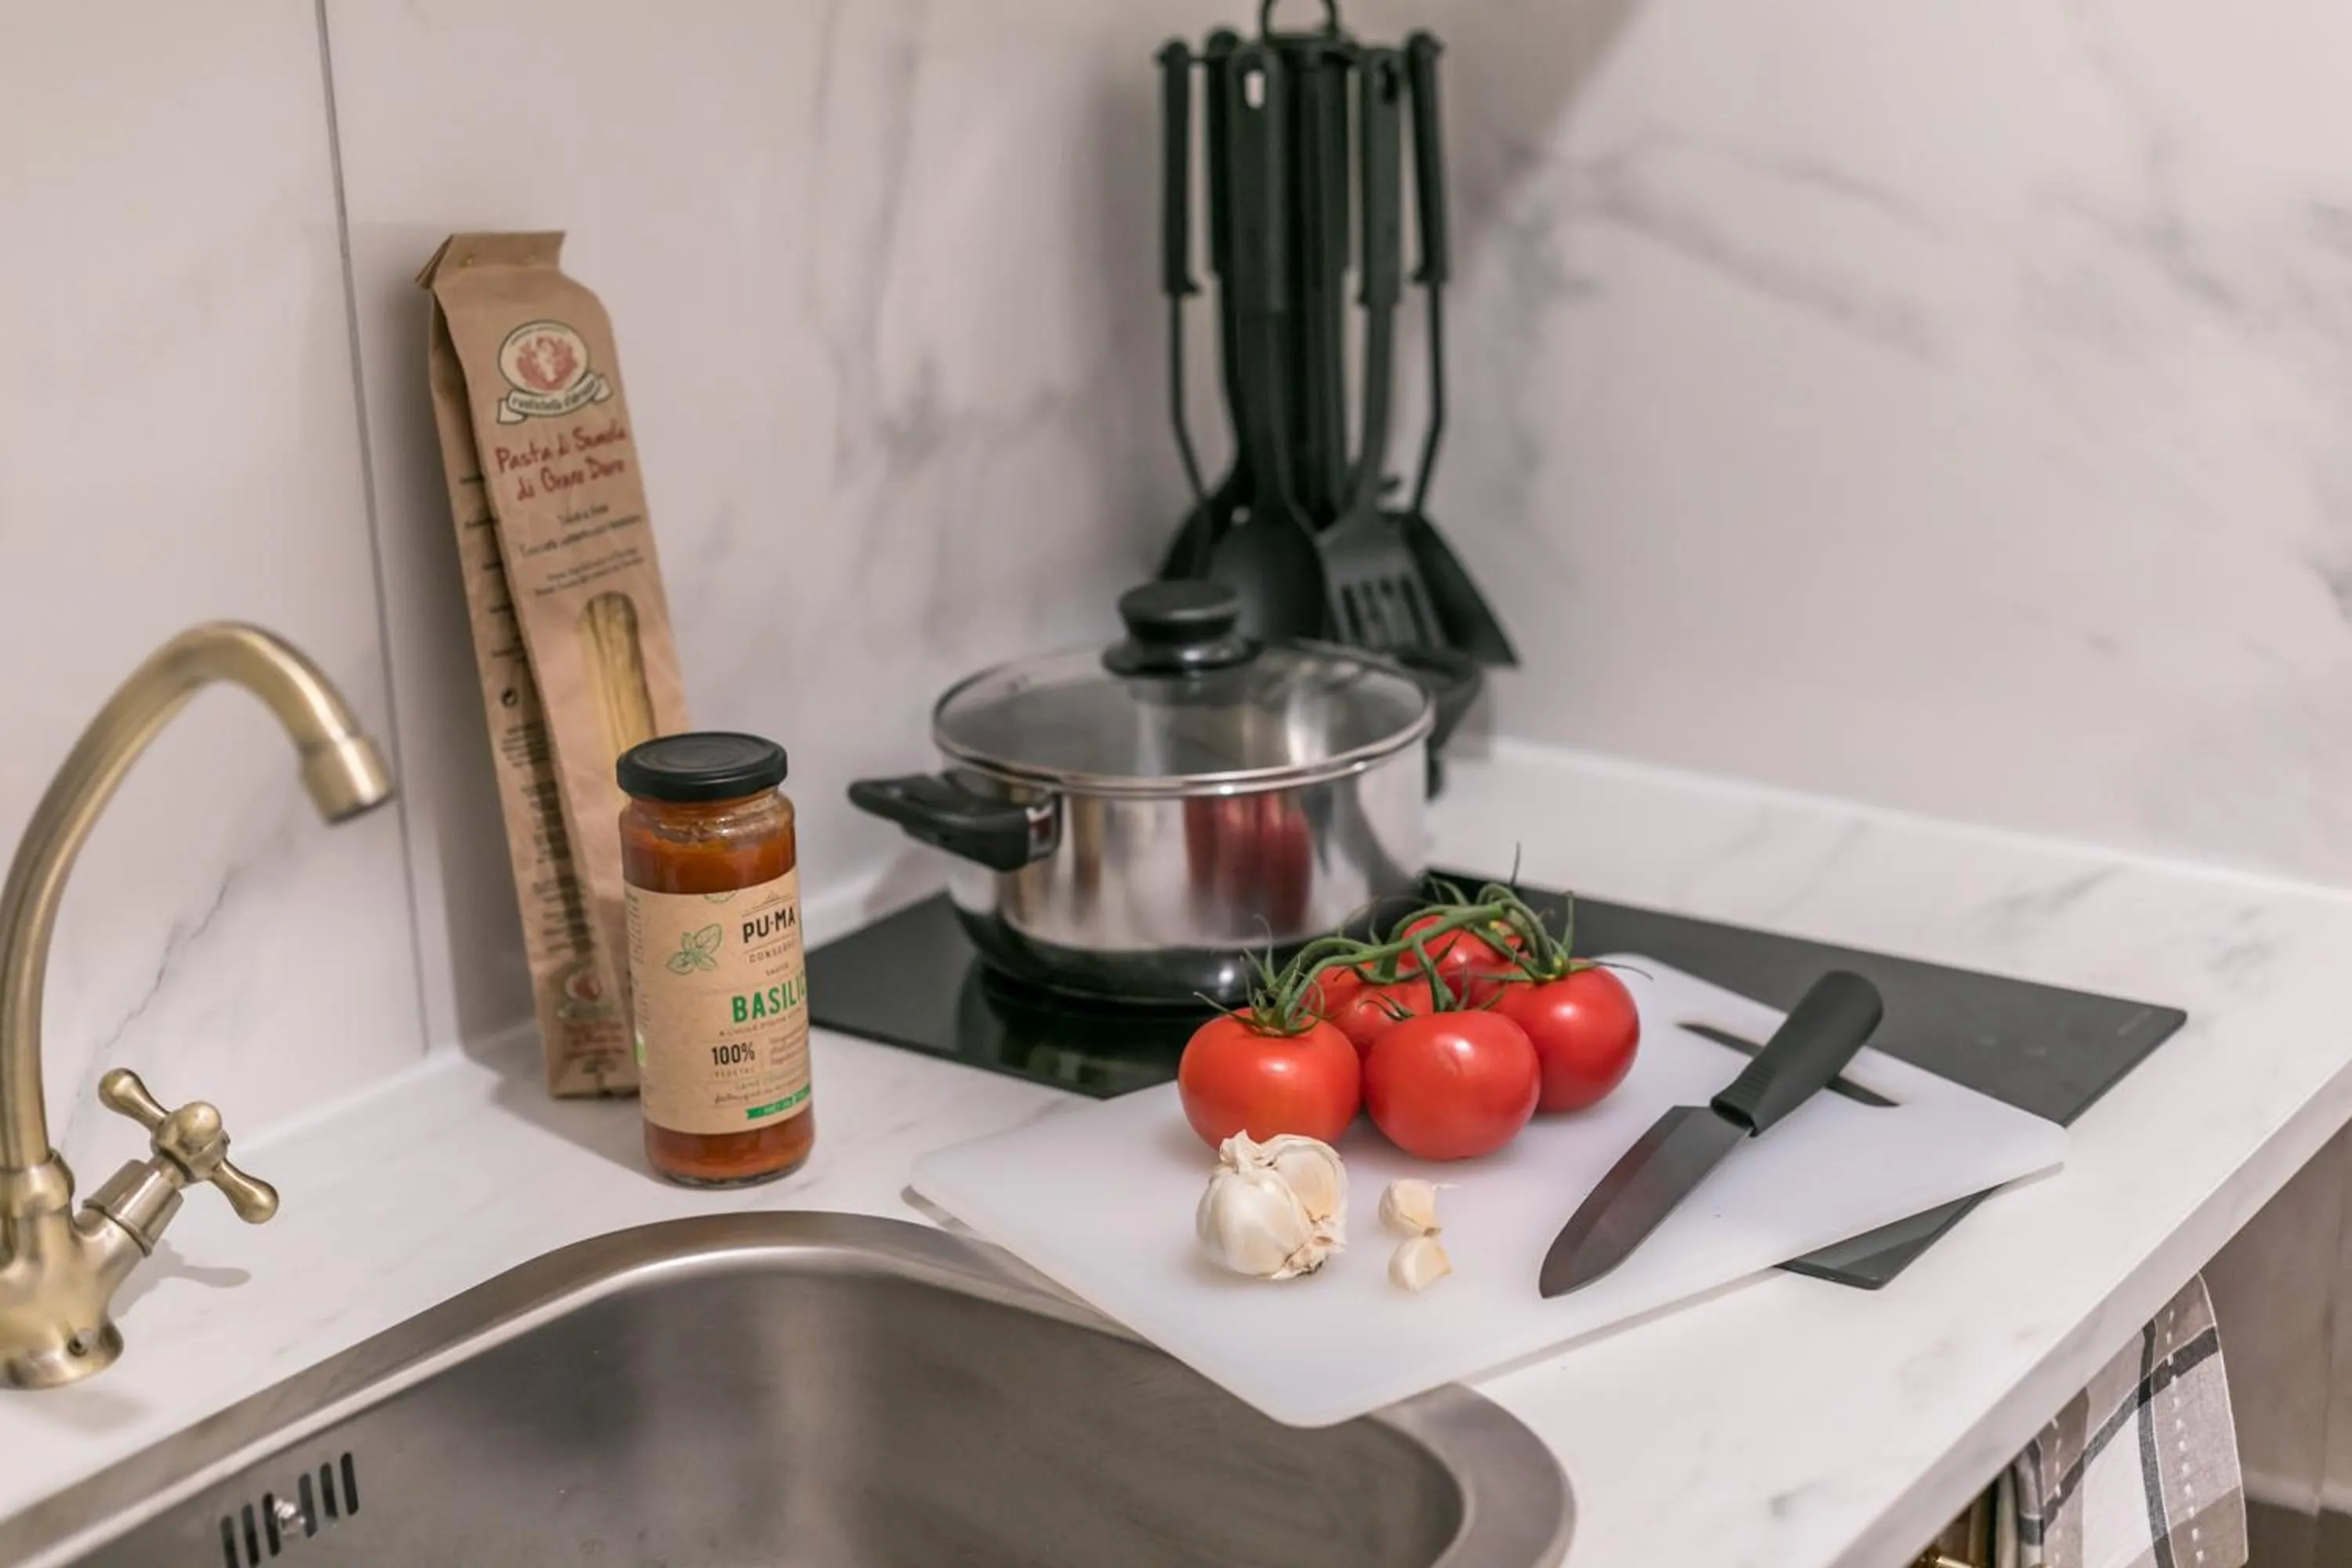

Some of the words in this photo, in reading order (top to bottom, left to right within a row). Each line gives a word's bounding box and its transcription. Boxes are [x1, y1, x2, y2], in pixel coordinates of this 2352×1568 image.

[495, 439, 552, 474] Pasta
[516, 477, 535, 501] di
[711, 1041, 756, 1065] 100%
